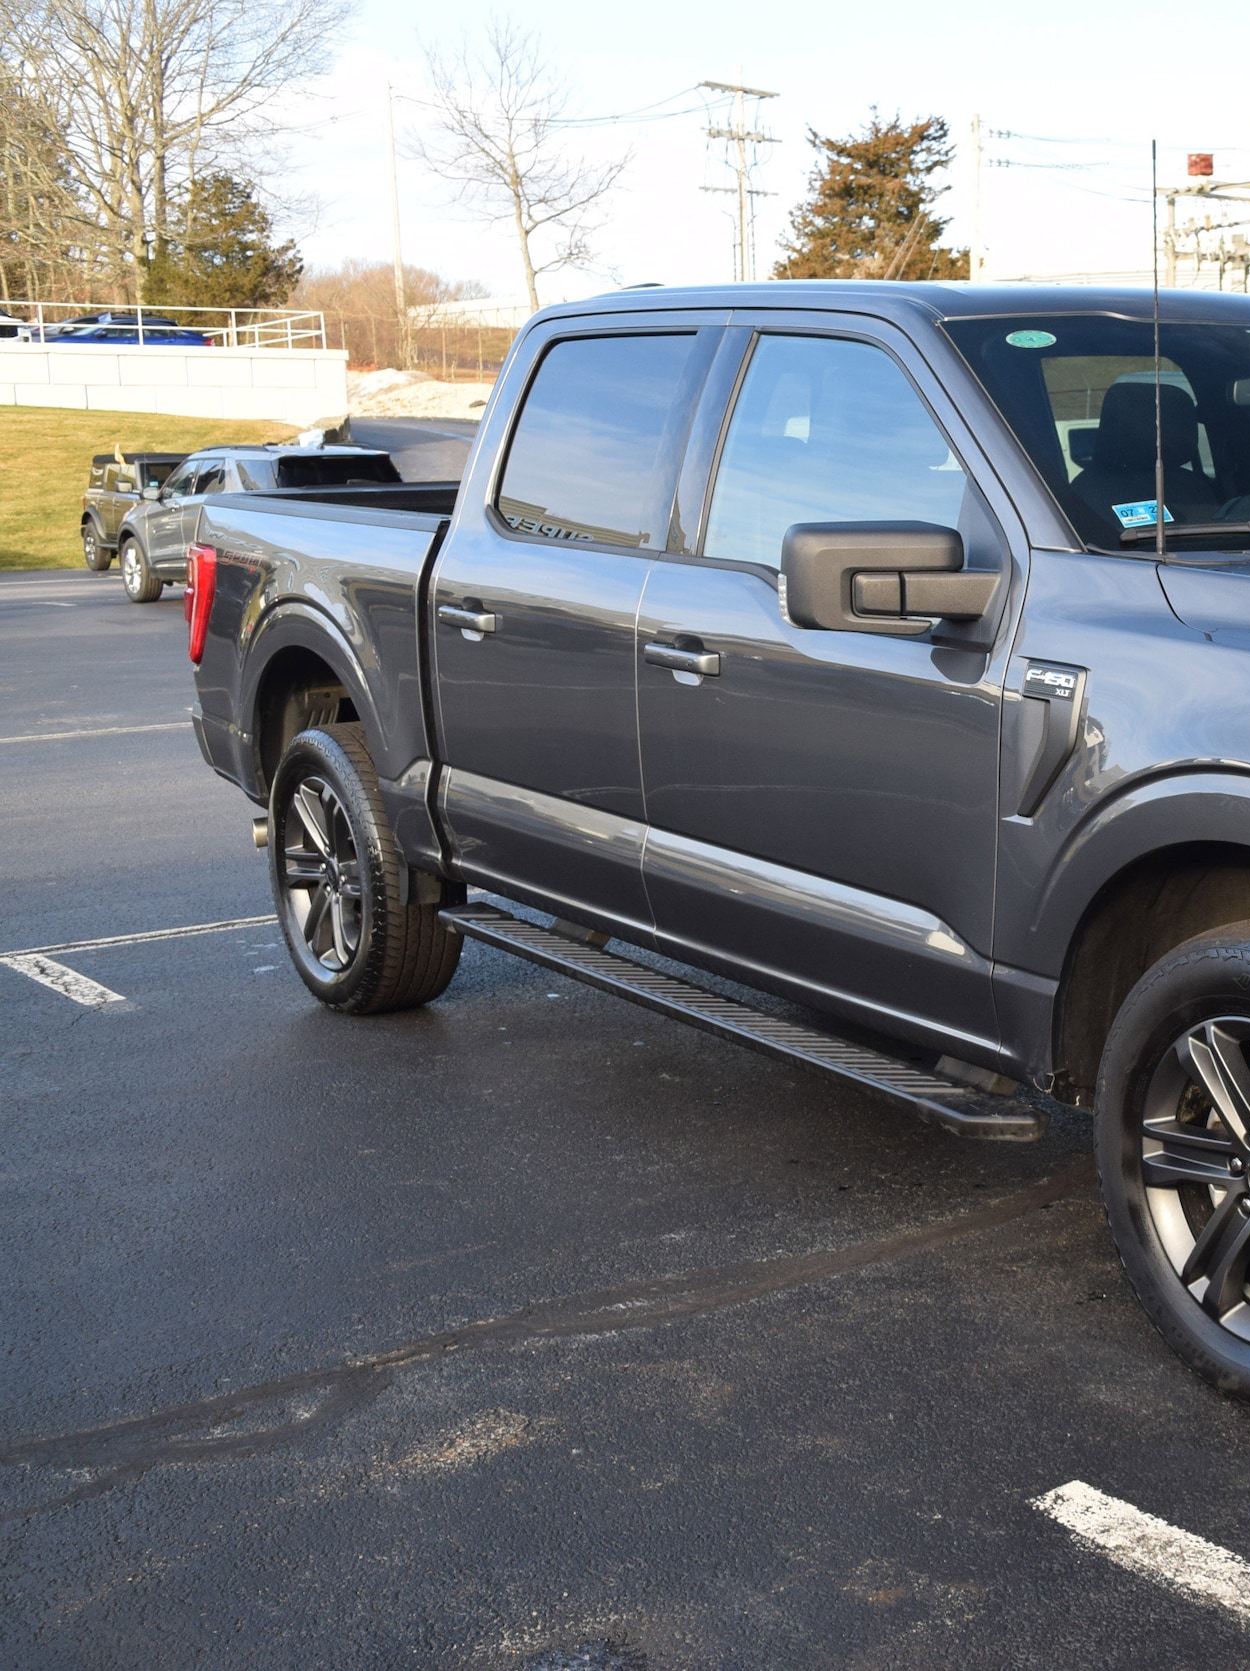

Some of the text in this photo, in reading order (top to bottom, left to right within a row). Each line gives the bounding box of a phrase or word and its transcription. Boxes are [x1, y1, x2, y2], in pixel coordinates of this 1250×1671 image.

[1120, 508, 1134, 518] 07
[220, 550, 269, 567] SPORT
[1026, 668, 1077, 688] F-150
[1055, 688, 1071, 697] XLT
